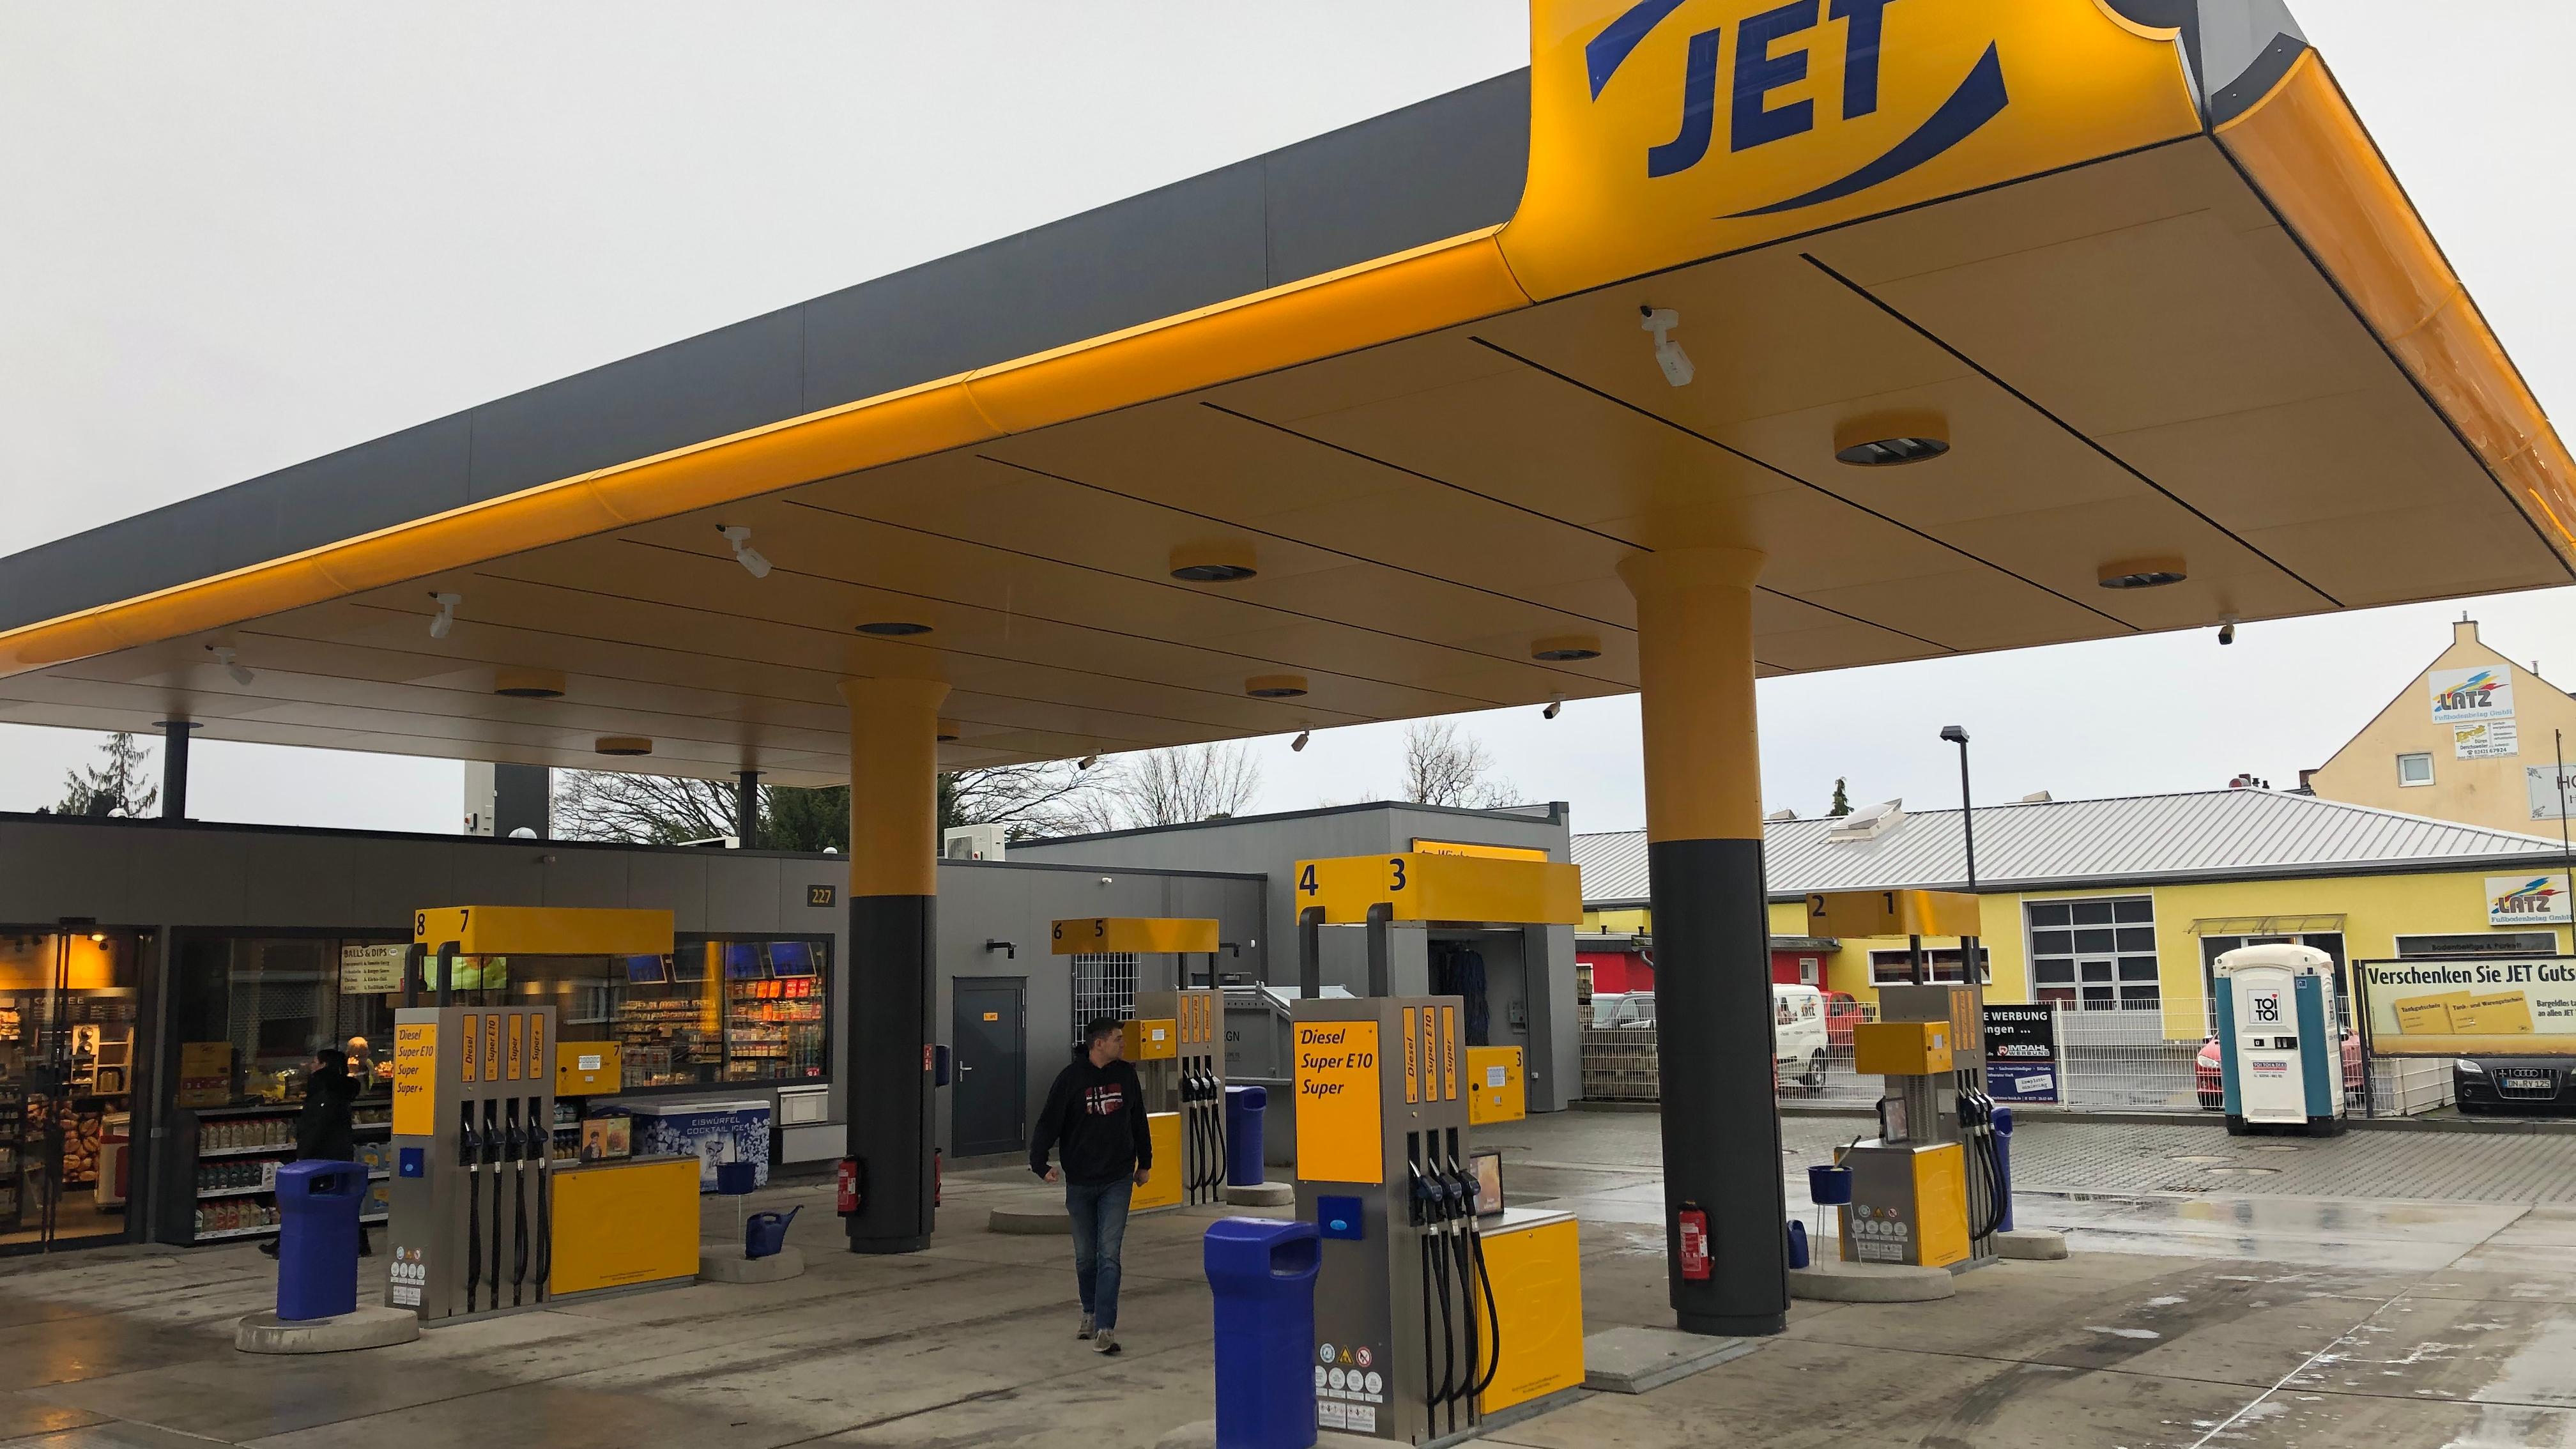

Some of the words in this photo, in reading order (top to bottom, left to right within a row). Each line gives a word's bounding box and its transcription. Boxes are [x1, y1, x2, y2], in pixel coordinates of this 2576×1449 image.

[1648, 0, 1896, 178] JET
[2440, 690, 2492, 710] LATZ
[2435, 712, 2488, 721] Fußbodenbelag
[1299, 864, 1319, 896] 4
[1390, 858, 1406, 891] 3
[812, 889, 831, 903] 227
[1883, 892, 1894, 914] 1
[2498, 896, 2551, 913] LATZ
[1812, 894, 1826, 916] 2
[417, 913, 425, 935] 8
[461, 909, 469, 932] 7
[1094, 919, 1103, 937] 5
[1054, 922, 1062, 939] 6
[344, 948, 364, 958] BALLS
[372, 948, 387, 957] DIPS
[2368, 965, 2472, 985] Verschenken
[2476, 965, 2501, 983] Sie
[2505, 965, 2533, 983] JET
[2538, 964, 2576, 982] Guts
[1983, 1011, 1989, 1021] E
[1991, 1011, 2048, 1021] WERBUNG
[2256, 1010, 2278, 1021] TOI
[399, 1029, 422, 1040] Diesel
[1141, 1023, 1146, 1032] 5
[1301, 1029, 1346, 1045] Diesel
[398, 1046, 419, 1060] Super
[420, 1045, 434, 1057] E10
[487, 1038, 497, 1063] Super
[510, 1037, 519, 1062] Super
[613, 1045, 620, 1056] 7
[1301, 1053, 1344, 1073] Super
[1346, 1052, 1373, 1068] E10
[1516, 1051, 1522, 1067] 3
[397, 1064, 418, 1078] Super
[1301, 1079, 1344, 1099] Super
[692, 1116, 740, 1126] EISWÜRFEL
[687, 1126, 728, 1135] COCKTAIL
